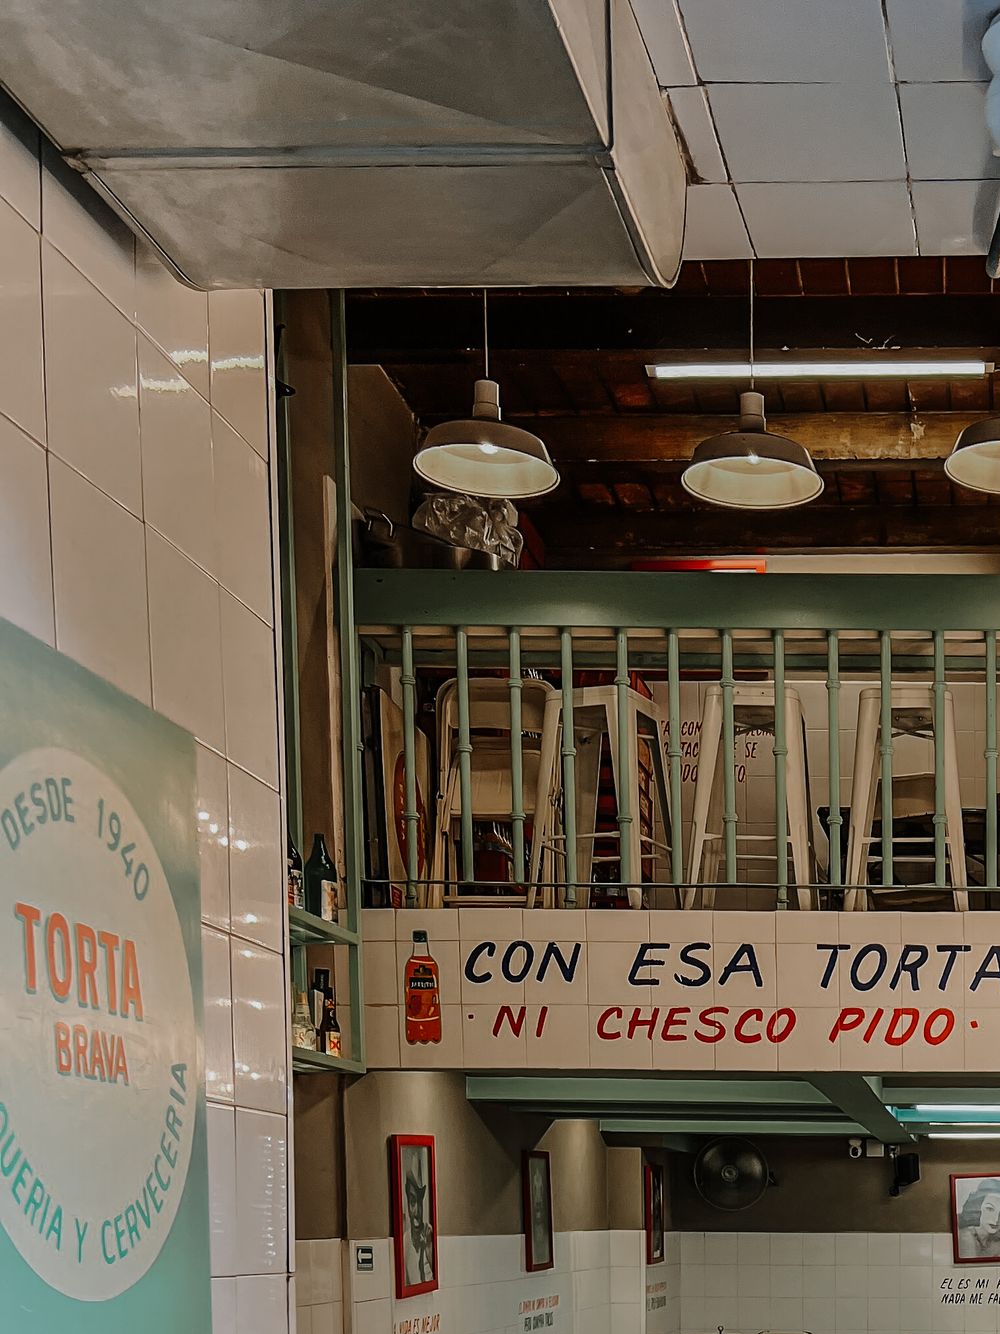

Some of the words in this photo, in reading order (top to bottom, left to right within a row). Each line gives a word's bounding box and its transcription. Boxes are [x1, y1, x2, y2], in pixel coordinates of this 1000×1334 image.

[1, 777, 75, 851] DESDE
[97, 798, 149, 901] 1940
[15, 902, 144, 1022] TORTA
[463, 939, 583, 985] CON
[628, 941, 764, 989] ESA
[55, 1021, 130, 1087] BRAVA
[492, 1005, 546, 1040] NI
[595, 1005, 798, 1045] CHESCO
[827, 1006, 957, 1046] PIDO
[75, 1217, 89, 1264] Y
[101, 1063, 188, 1265] CERVECERIA
[940, 1277, 954, 1290] EL
[957, 1278, 972, 1290] ES
[975, 1278, 990, 1290] MI
[941, 1292, 966, 1305] NADA
[968, 1292, 983, 1305] ME
